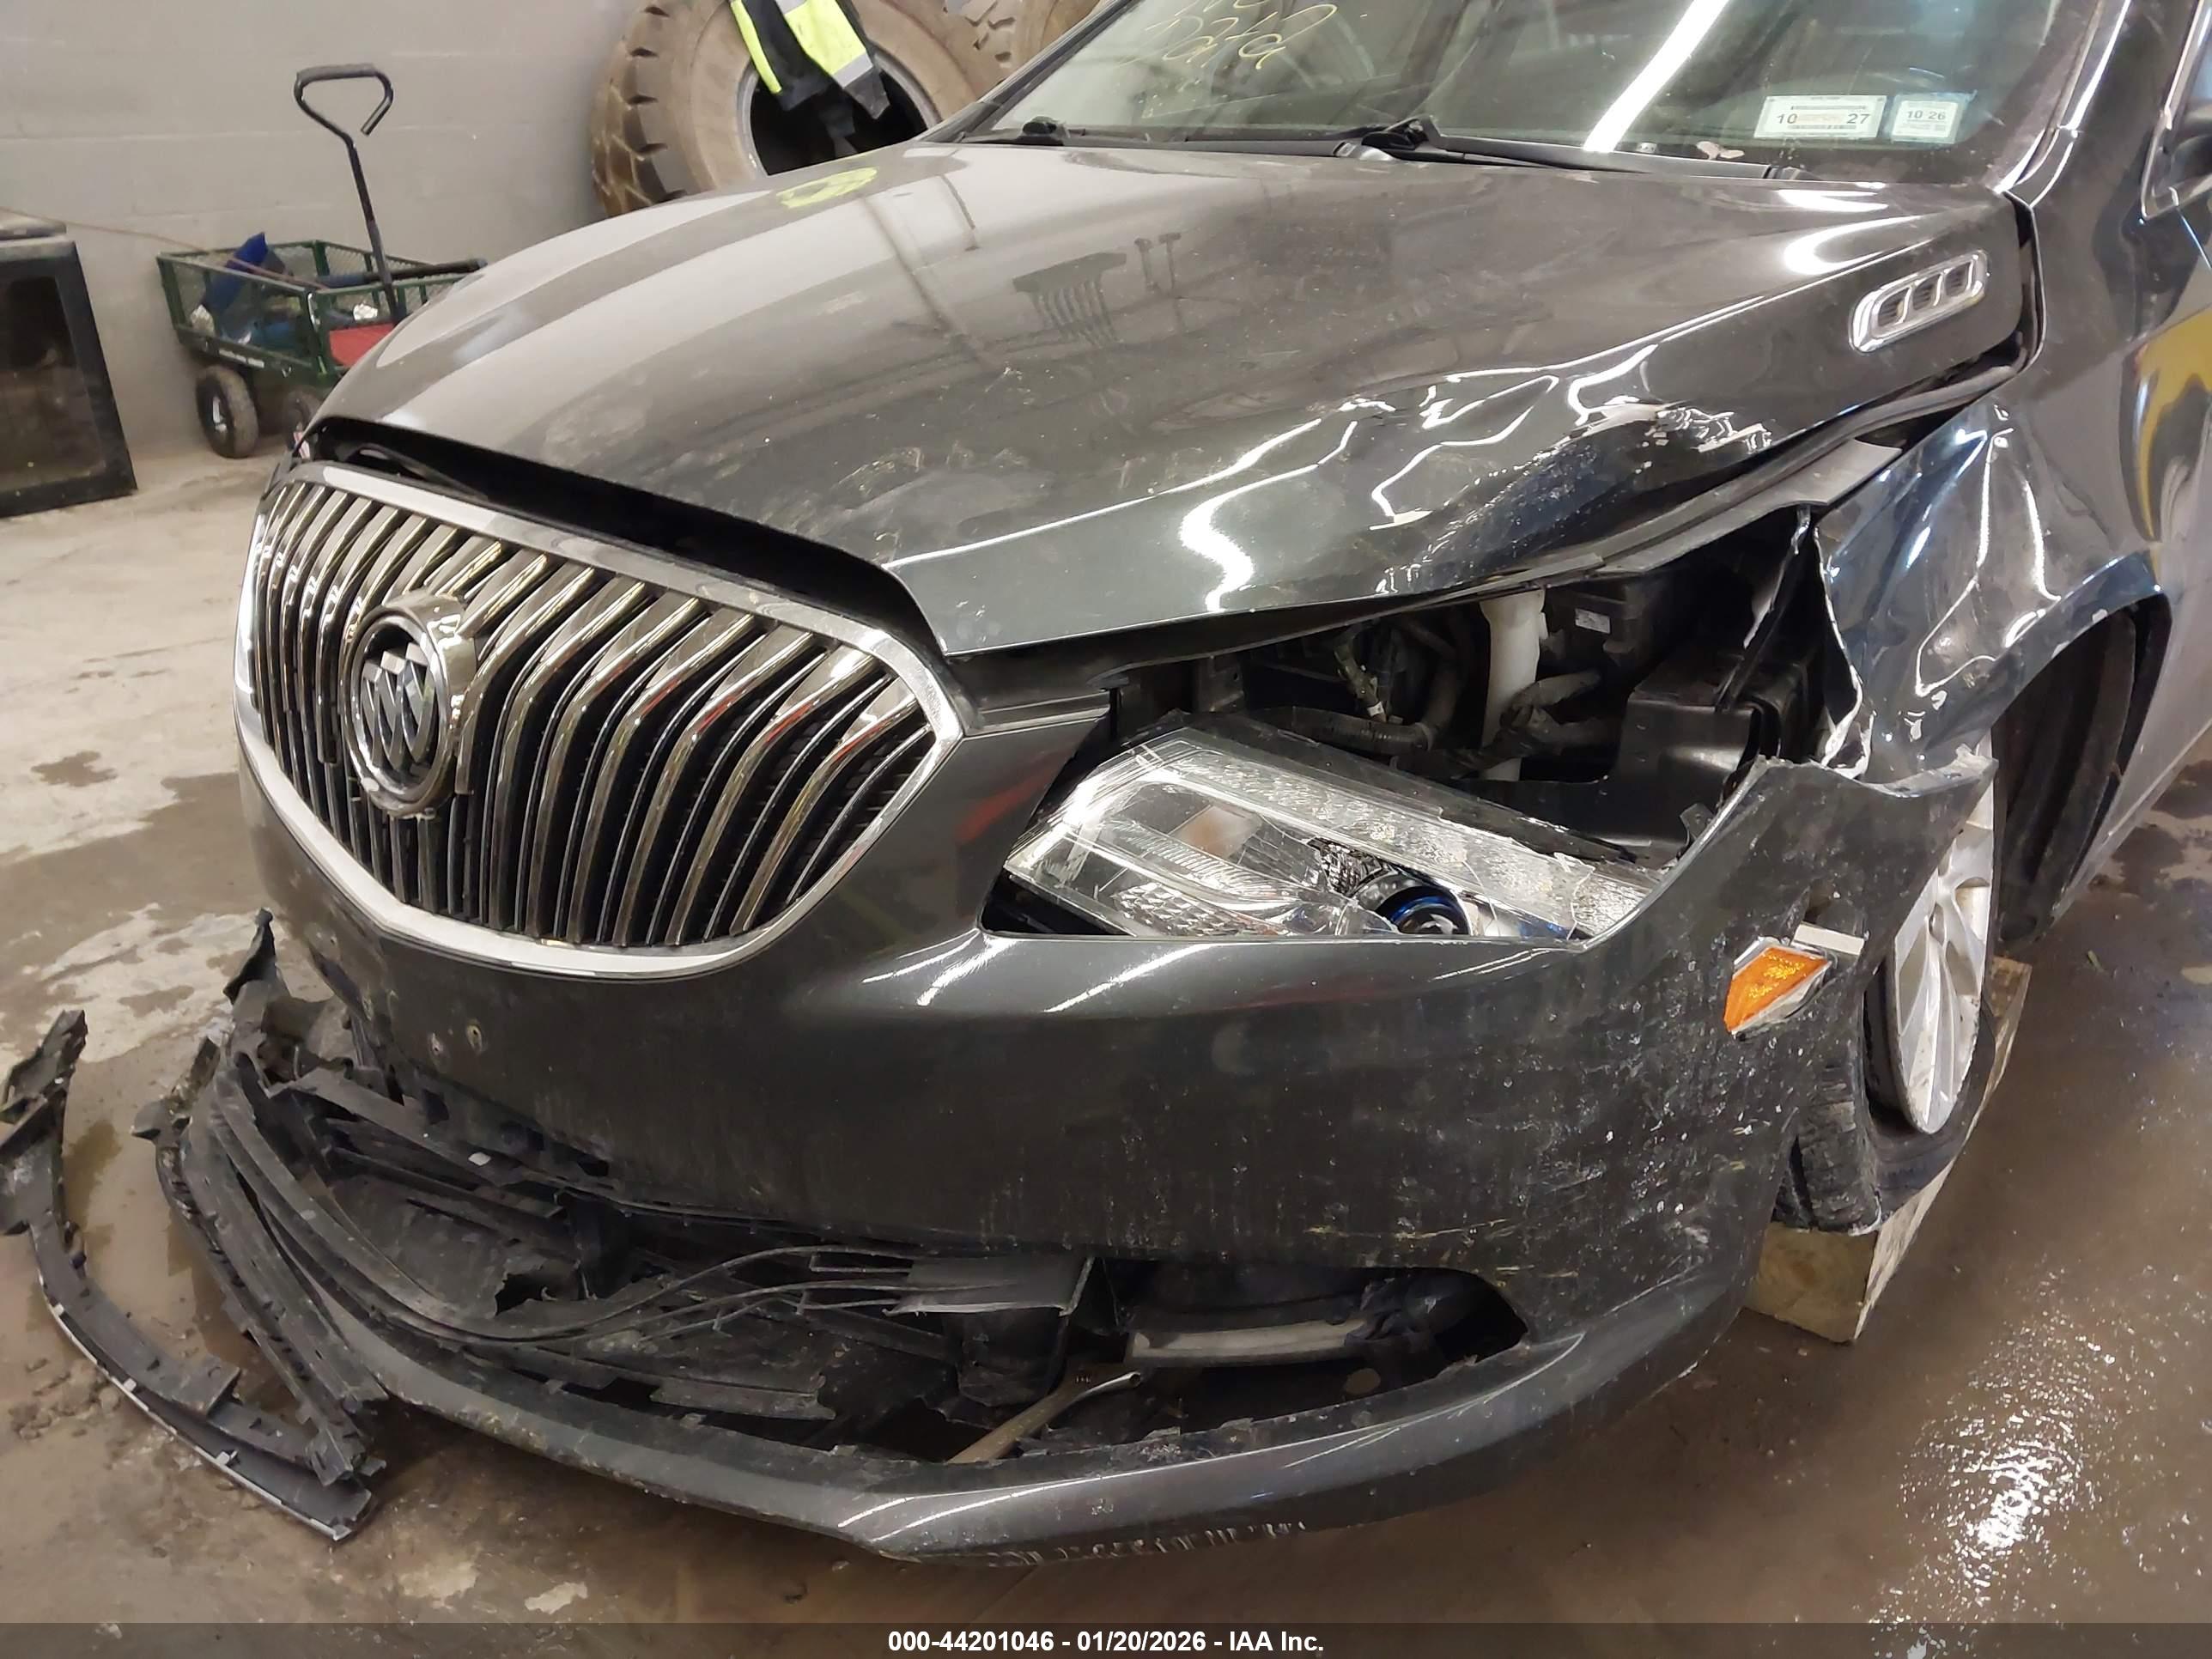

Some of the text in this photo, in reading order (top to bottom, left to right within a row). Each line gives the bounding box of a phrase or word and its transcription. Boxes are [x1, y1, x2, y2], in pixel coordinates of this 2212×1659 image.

[1776, 112, 1798, 125] 10
[1846, 112, 1870, 125] 27
[1906, 110, 1946, 120] 10 26
